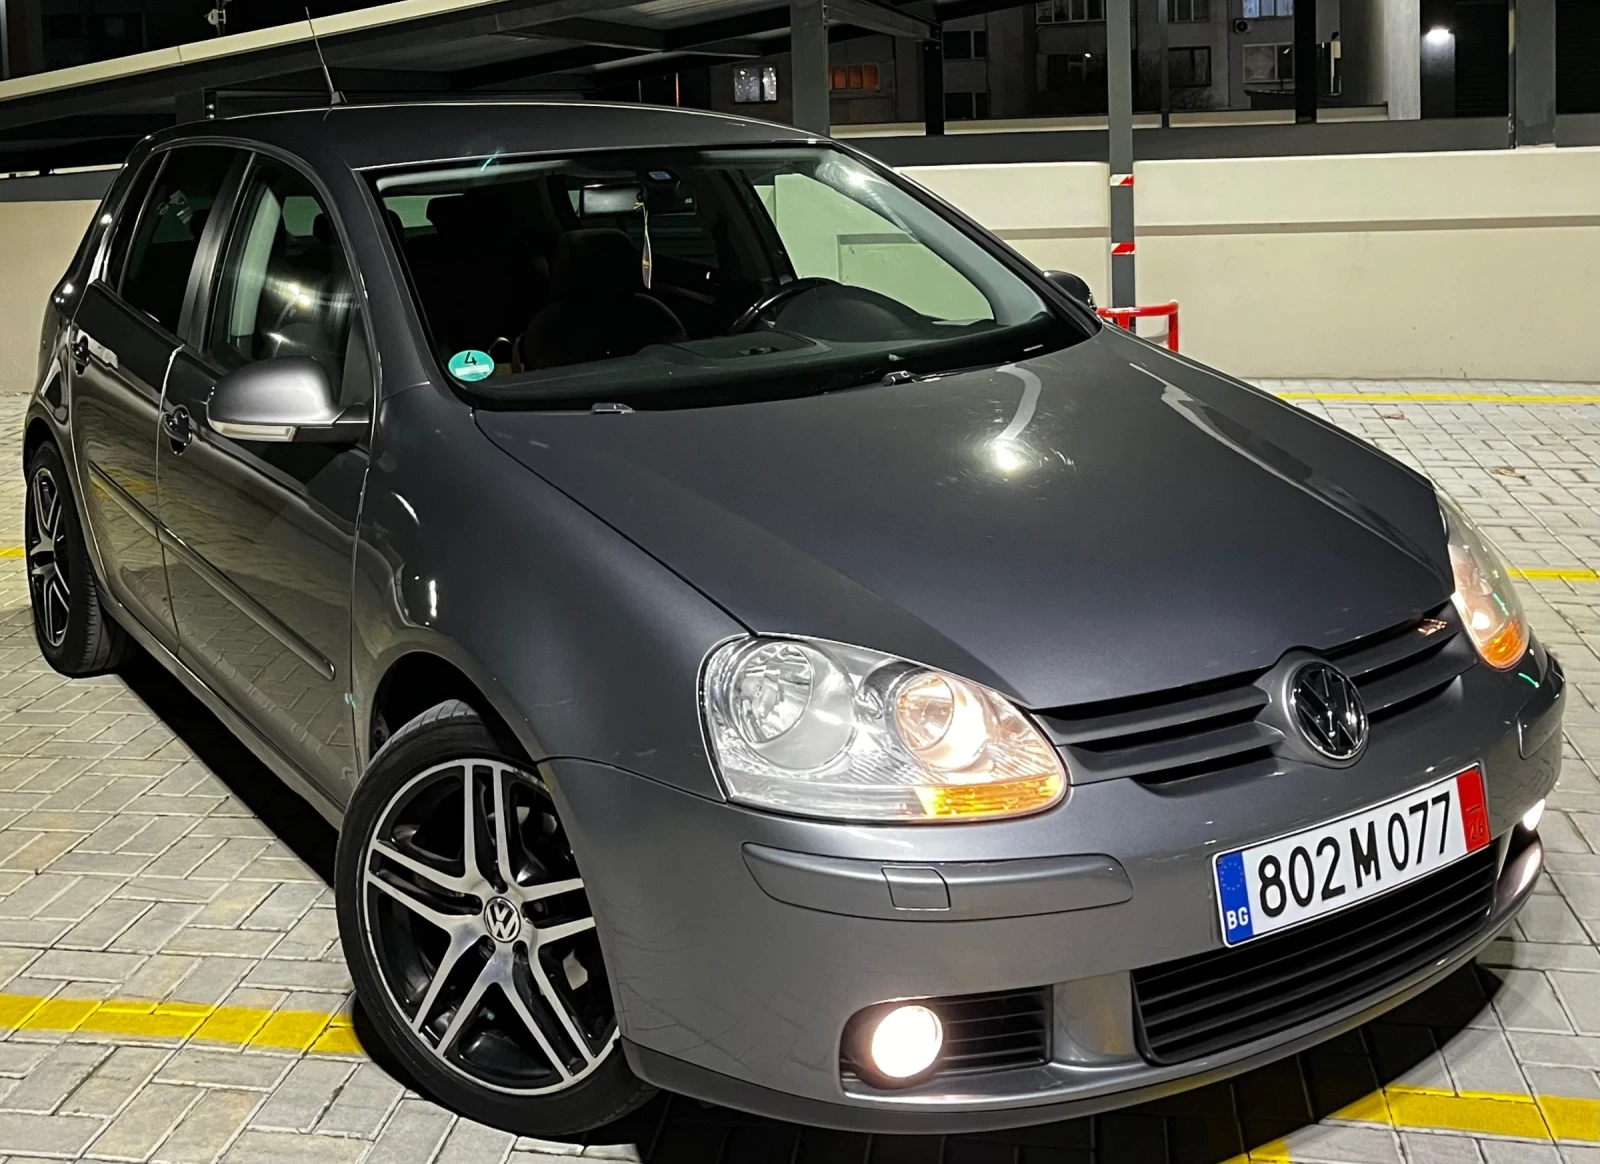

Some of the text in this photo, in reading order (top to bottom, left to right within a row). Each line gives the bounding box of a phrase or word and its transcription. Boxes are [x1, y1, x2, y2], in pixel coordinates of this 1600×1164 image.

[464, 351, 478, 365] 4
[484, 897, 520, 942] VW
[1226, 906, 1249, 930] BG
